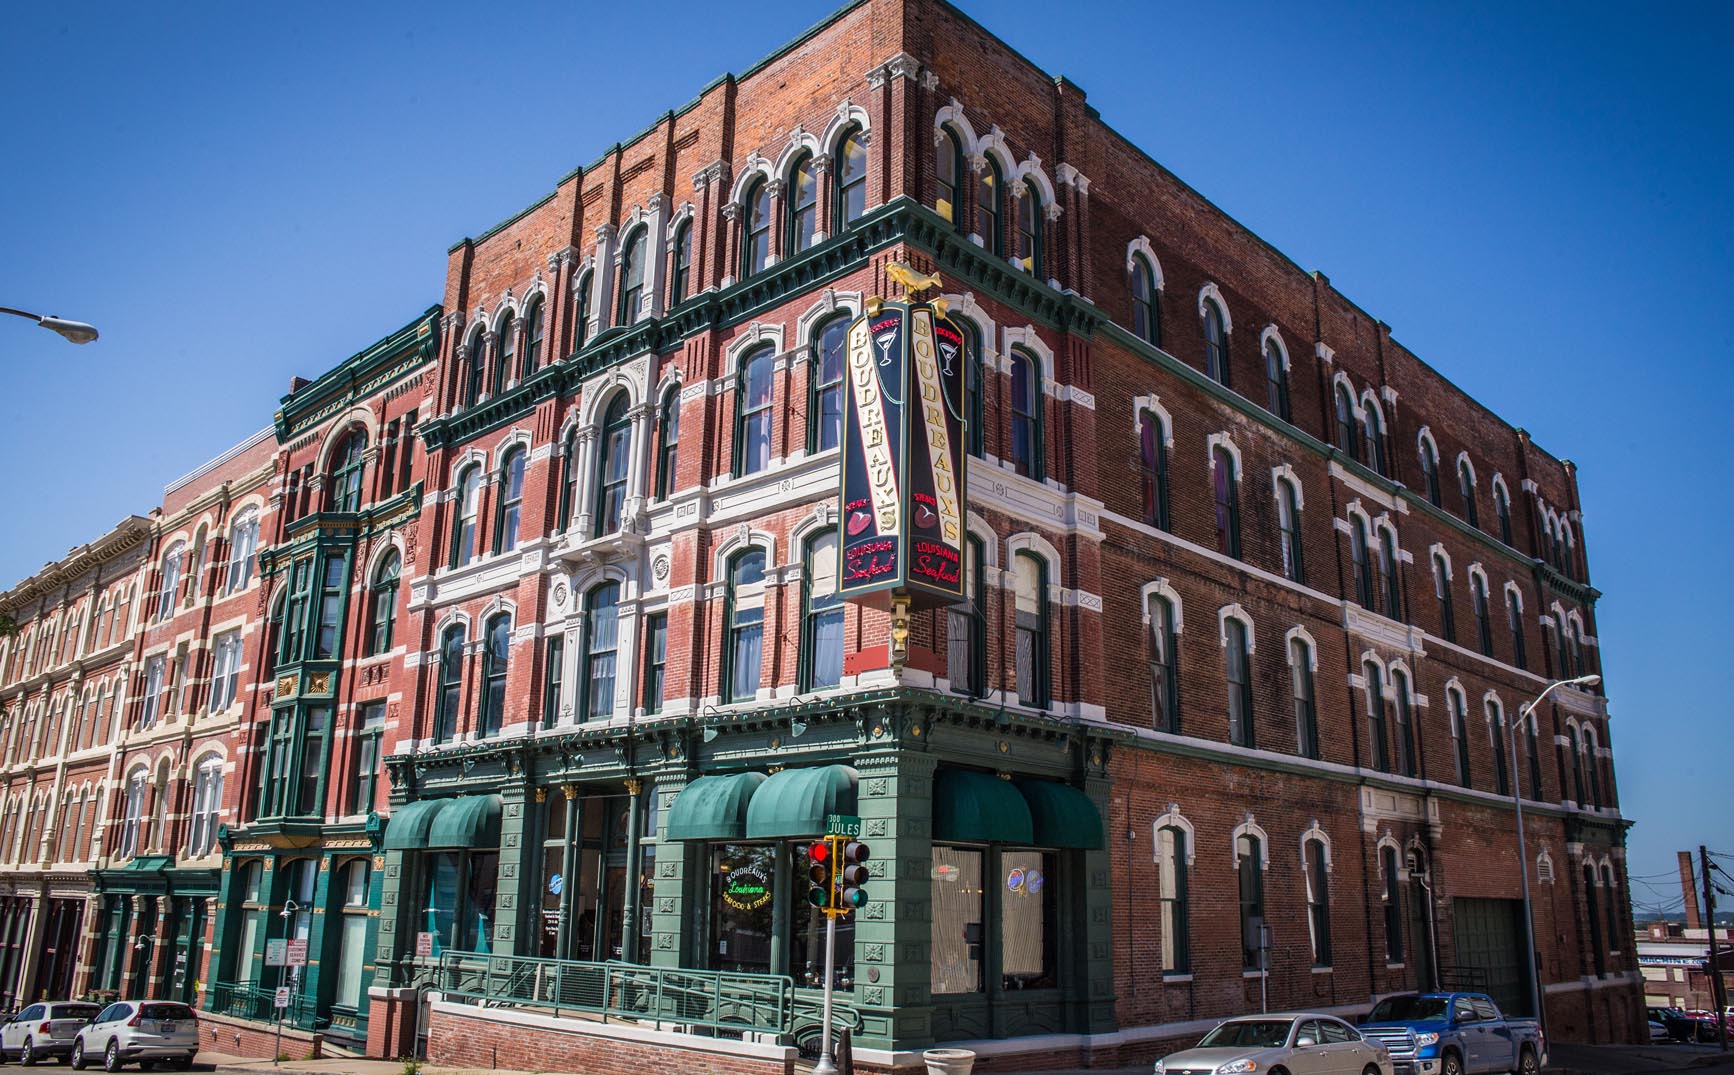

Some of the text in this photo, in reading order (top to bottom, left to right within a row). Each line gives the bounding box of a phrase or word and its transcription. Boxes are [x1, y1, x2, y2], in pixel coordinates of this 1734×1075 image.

[851, 331, 897, 532] BOUDREAUX'S
[913, 316, 958, 540] BOUDREAUX'S
[914, 493, 937, 506] STEAKS
[846, 540, 893, 559] LOUISIANA
[917, 542, 958, 562] LOUISIANA
[843, 553, 896, 582] Seafood
[913, 555, 961, 583] Seafood
[829, 814, 840, 823] 300
[828, 824, 859, 835] JULES
[726, 865, 768, 884] BOUDREAUX'S
[728, 880, 765, 894] Louisiana
[722, 891, 772, 910] SEAFOOD & STEAKS
[1639, 957, 1689, 965] MACHINE
